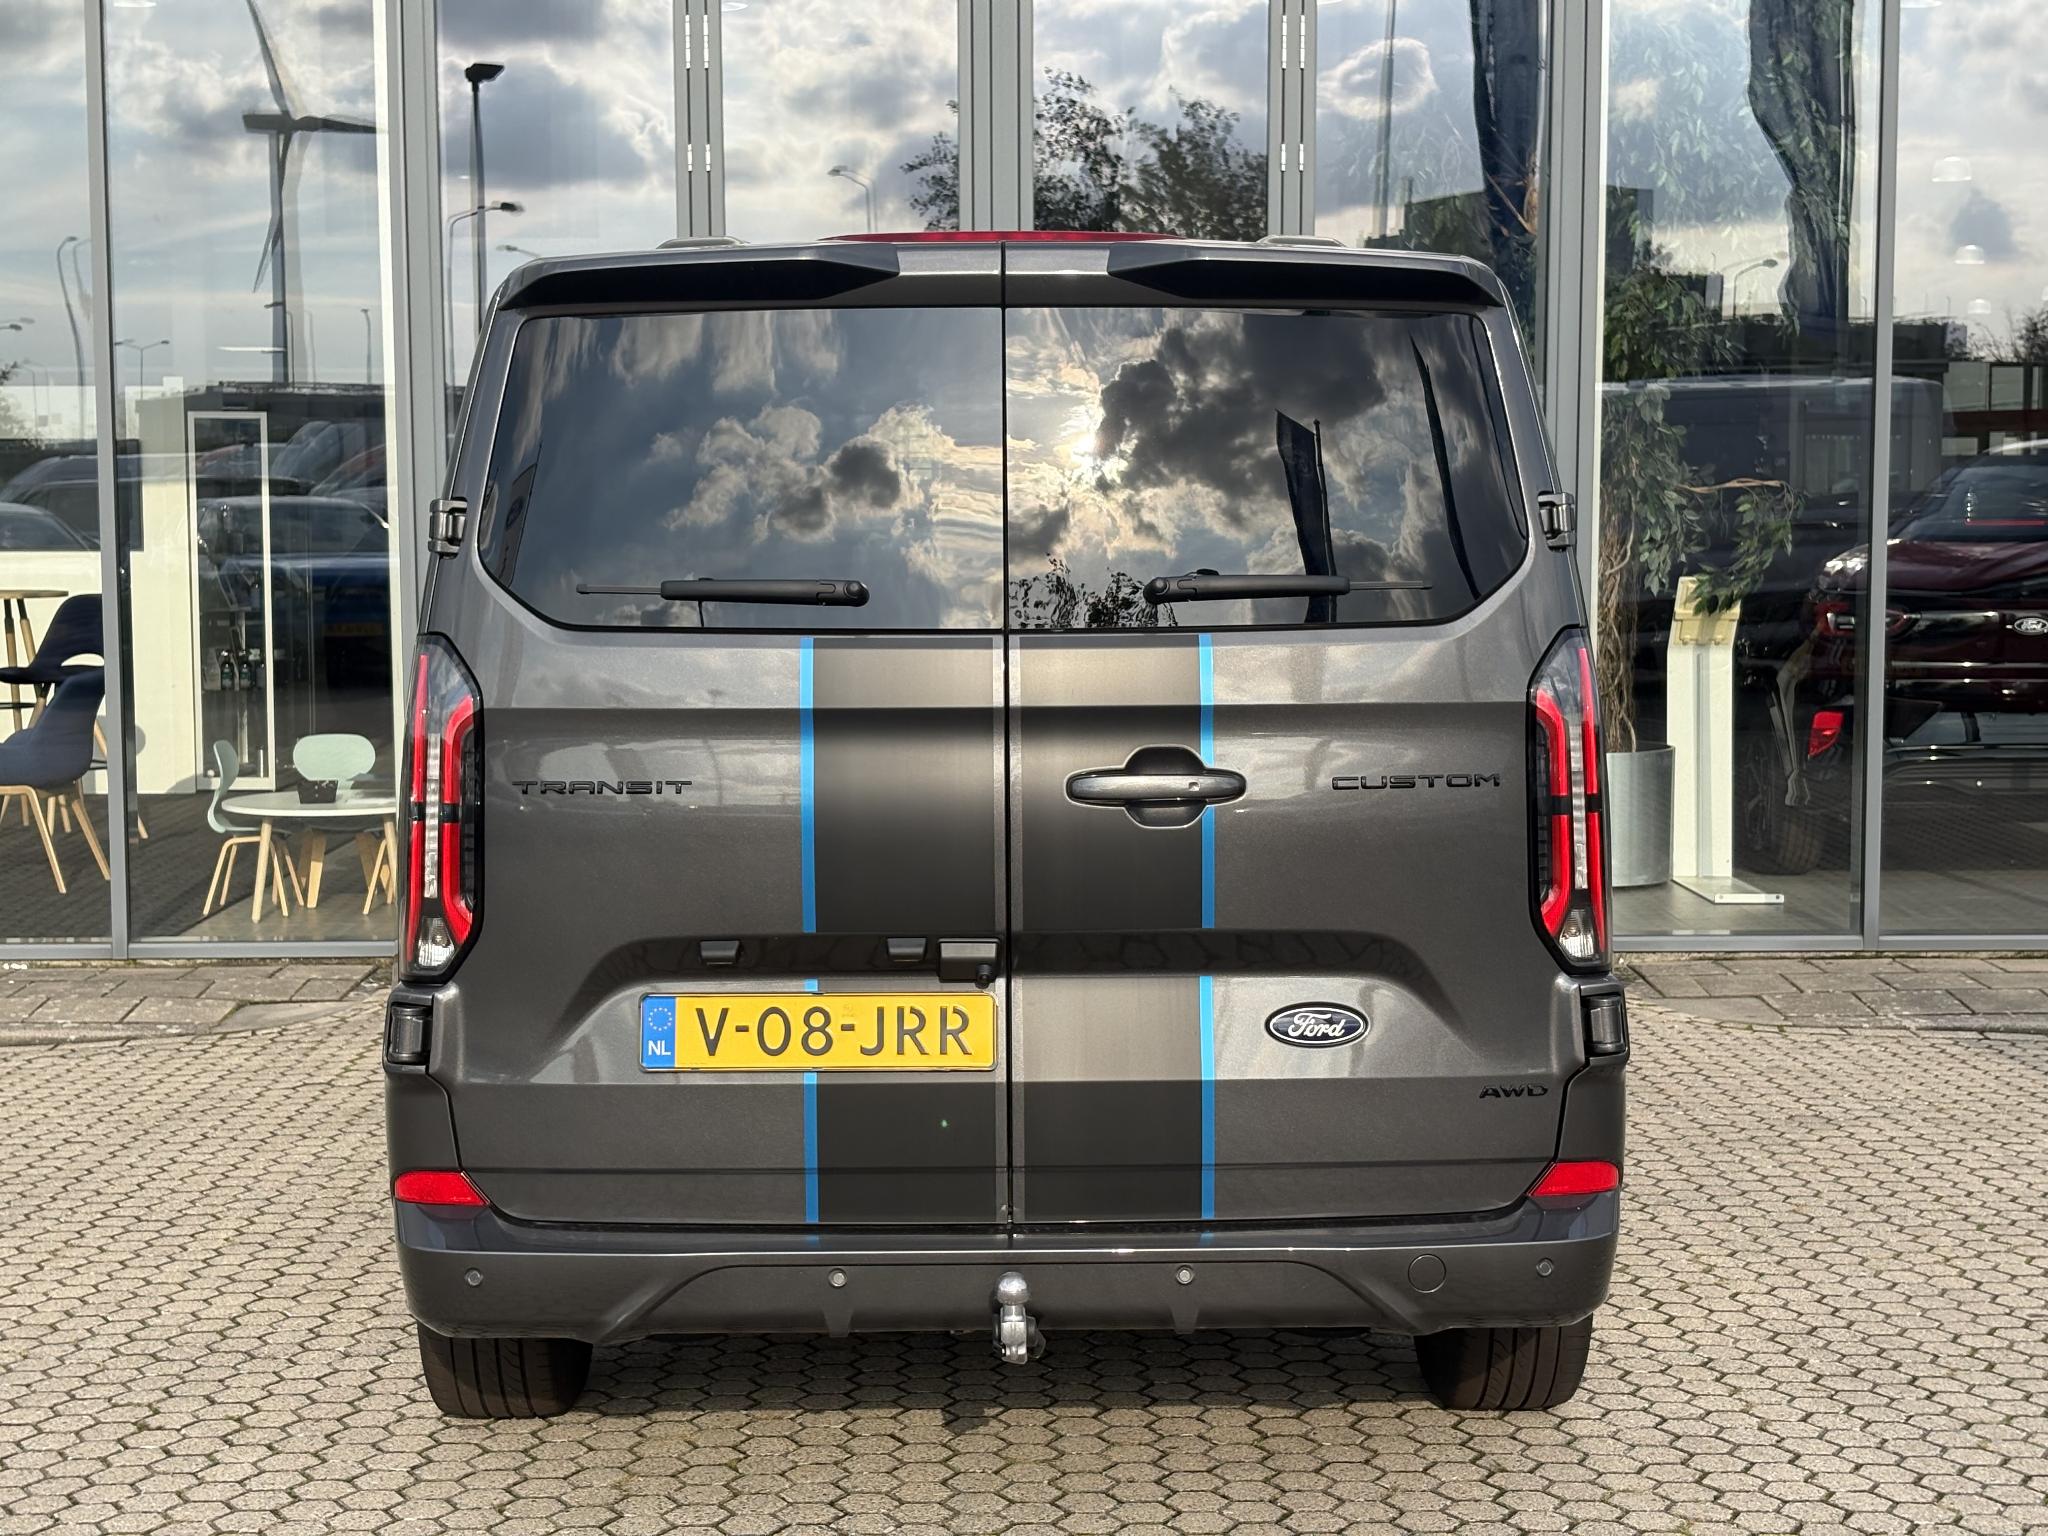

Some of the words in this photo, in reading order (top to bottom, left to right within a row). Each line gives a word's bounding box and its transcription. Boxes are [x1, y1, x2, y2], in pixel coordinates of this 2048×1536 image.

[512, 780, 692, 795] TRANSIT
[1332, 773, 1500, 790] CUSTOM
[696, 1006, 973, 1057] V-08-JRR
[1287, 1012, 1346, 1037] Ford
[648, 1039, 672, 1056] NL
[1479, 1083, 1548, 1099] AWD
